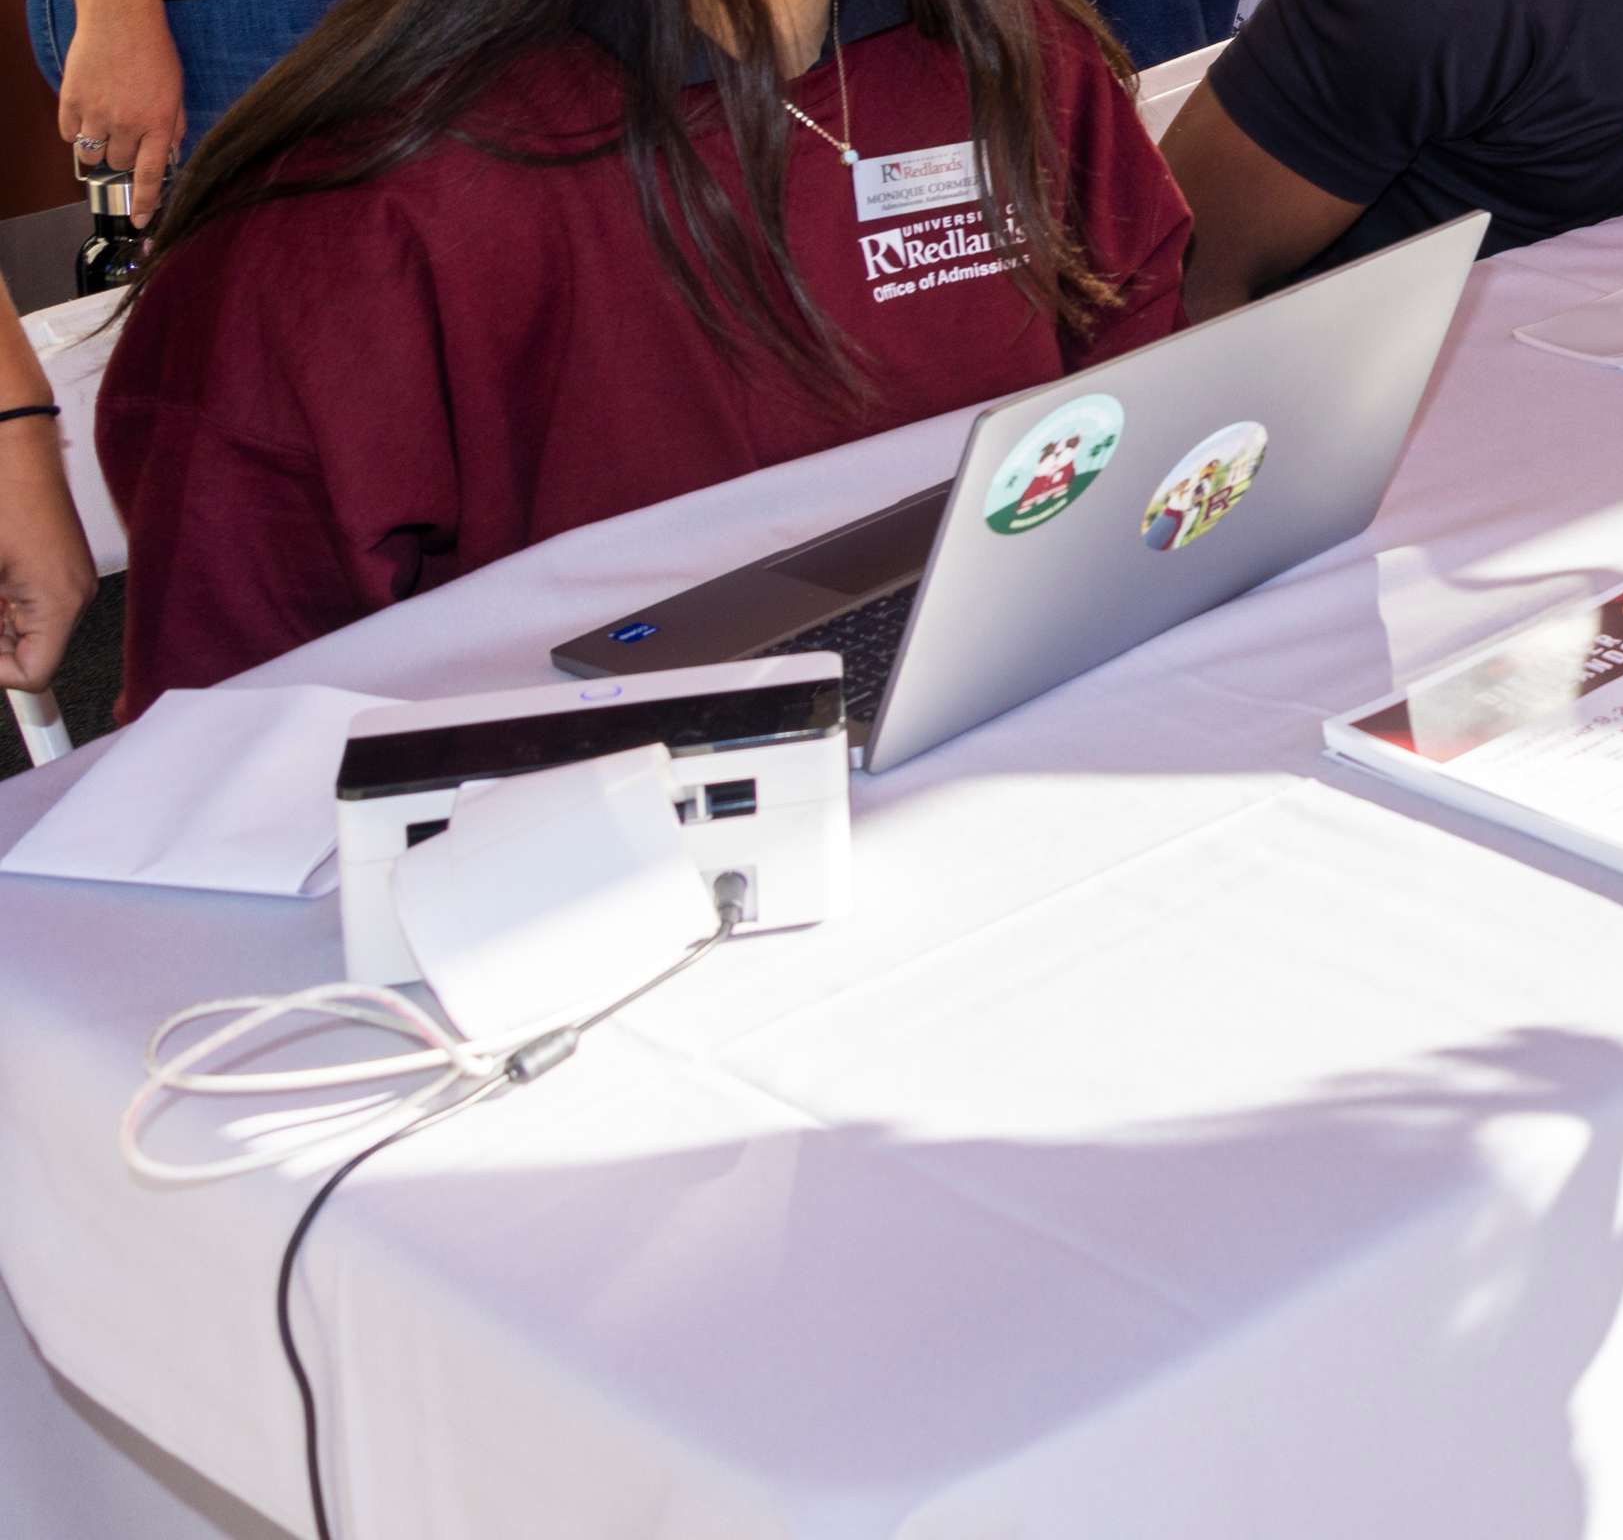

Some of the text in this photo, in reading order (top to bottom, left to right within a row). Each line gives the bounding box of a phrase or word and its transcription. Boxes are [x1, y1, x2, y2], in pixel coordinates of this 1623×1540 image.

[903, 157, 963, 179] Redlands
[867, 185, 926, 206] MONIQUE
[902, 210, 984, 238] UNIVERSI
[873, 279, 917, 304] Office
[918, 273, 936, 291] of
